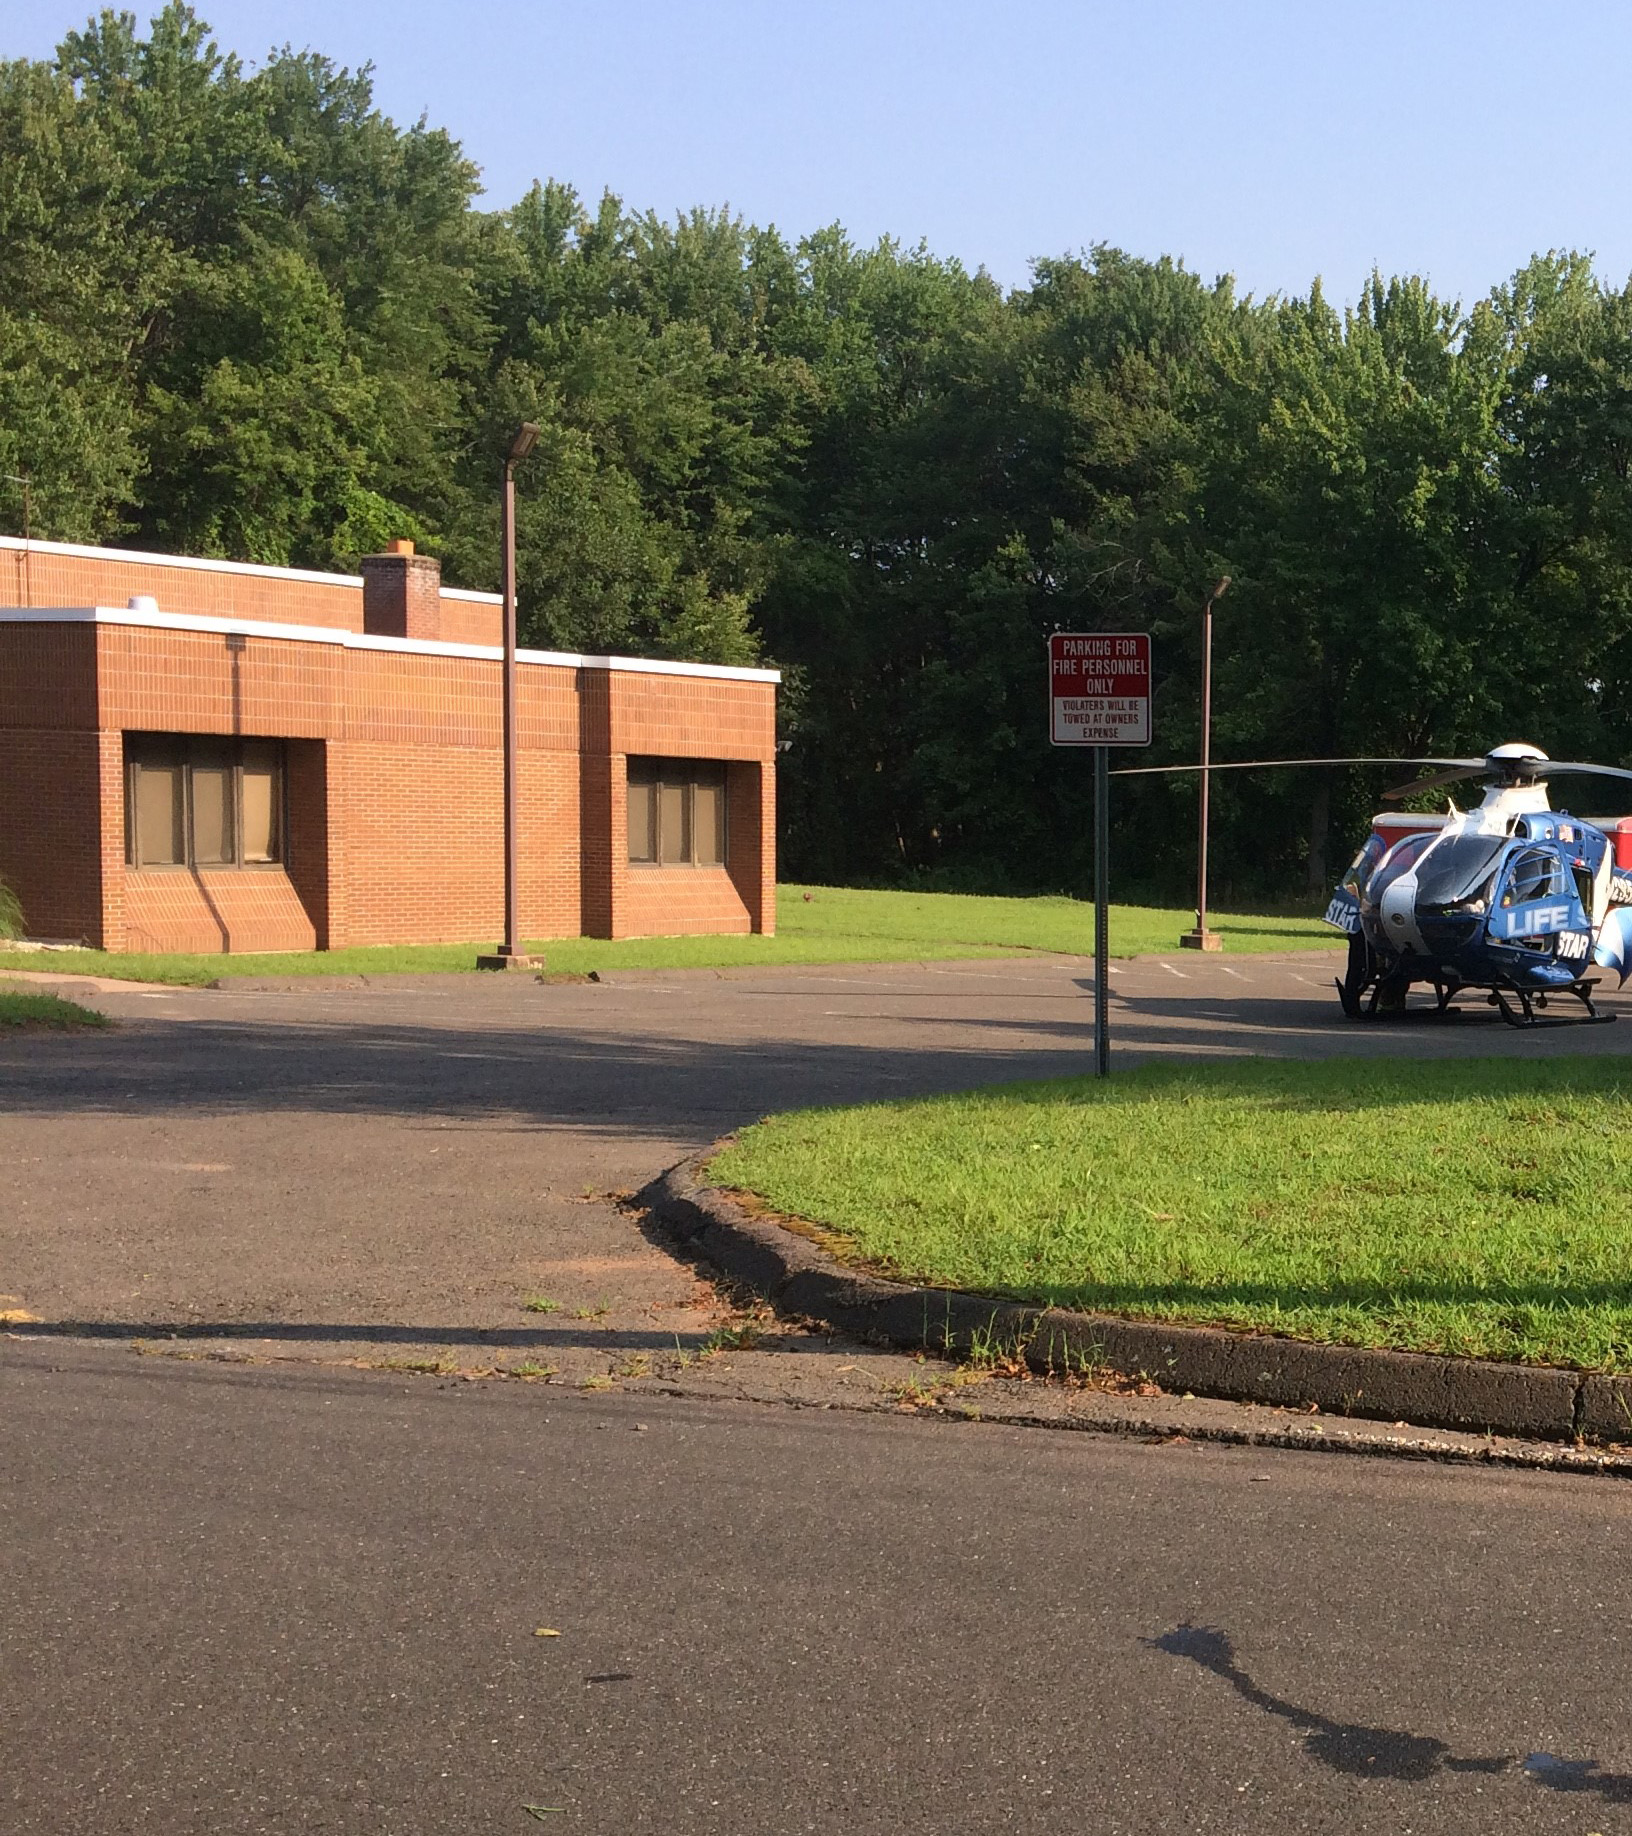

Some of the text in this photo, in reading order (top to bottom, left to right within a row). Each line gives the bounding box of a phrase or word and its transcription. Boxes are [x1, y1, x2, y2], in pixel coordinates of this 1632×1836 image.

[1063, 640, 1137, 656] PARKING FOR
[1053, 659, 1147, 675] FIRE PERSONNEL
[1086, 678, 1114, 694] ONLY
[1107, 700, 1126, 711] WILL
[1128, 700, 1139, 711] BE
[1063, 713, 1139, 724] TOWED AT OWNERS
[1083, 727, 1119, 739] EXPENSE
[1325, 898, 1358, 932] STAR
[1507, 905, 1570, 938] LIFE
[1556, 930, 1590, 960] STAR
